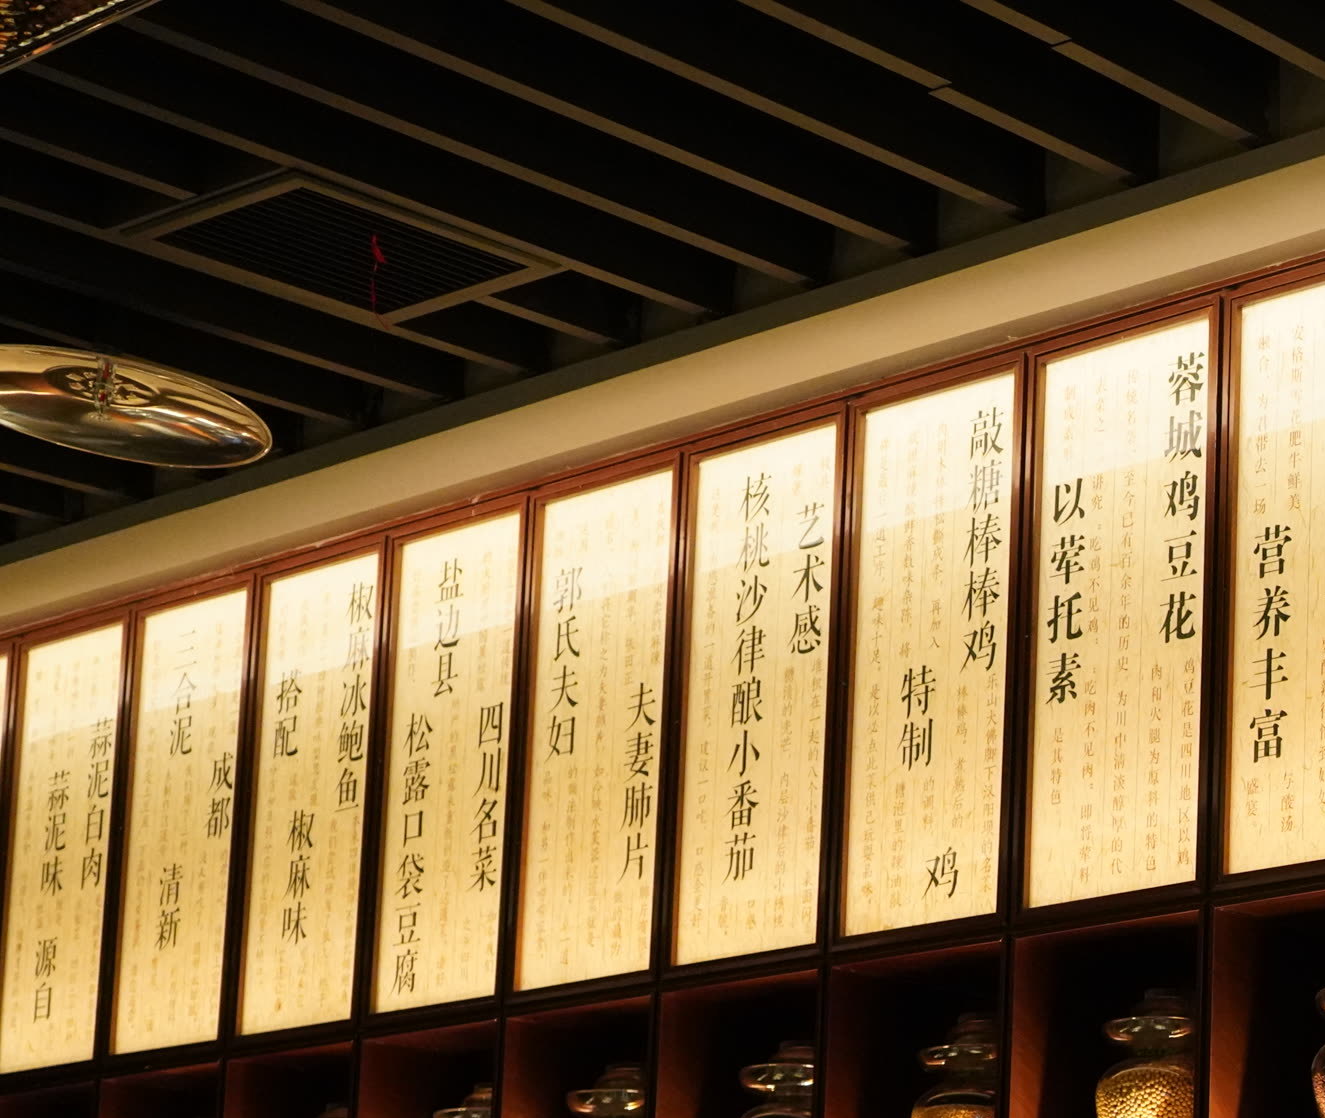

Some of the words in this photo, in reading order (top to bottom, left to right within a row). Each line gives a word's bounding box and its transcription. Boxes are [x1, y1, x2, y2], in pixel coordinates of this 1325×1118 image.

[787, 502, 825, 655] 艺术感
[960, 407, 1004, 672] 敲糖棒棒鸡
[1161, 352, 1204, 644] 蓉城鸡豆花
[432, 558, 463, 698] 盐边县
[545, 566, 583, 763] 郭氏夫妇
[1046, 477, 1086, 705] 以荤托素
[1249, 525, 1293, 764] 营养丰富
[169, 628, 199, 760] 三合泥
[272, 669, 302, 758] 搭配
[335, 582, 374, 812] 椒麻冰鲍鱼
[722, 472, 772, 887] 核桃沙律酿小番茄
[897, 664, 936, 771] 特制
[40, 770, 71, 897] 蒜泥味
[81, 717, 113, 890] 蒜泥白肉
[204, 752, 233, 839] 成都
[391, 713, 433, 996] 松露口袋豆腐
[466, 702, 503, 892] 四川名菜
[619, 682, 656, 884] 夫妻肺片
[154, 863, 183, 951] 清新
[281, 810, 314, 945] 椒麻味
[922, 846, 959, 903] 鸡
[34, 937, 58, 1024] 源自
